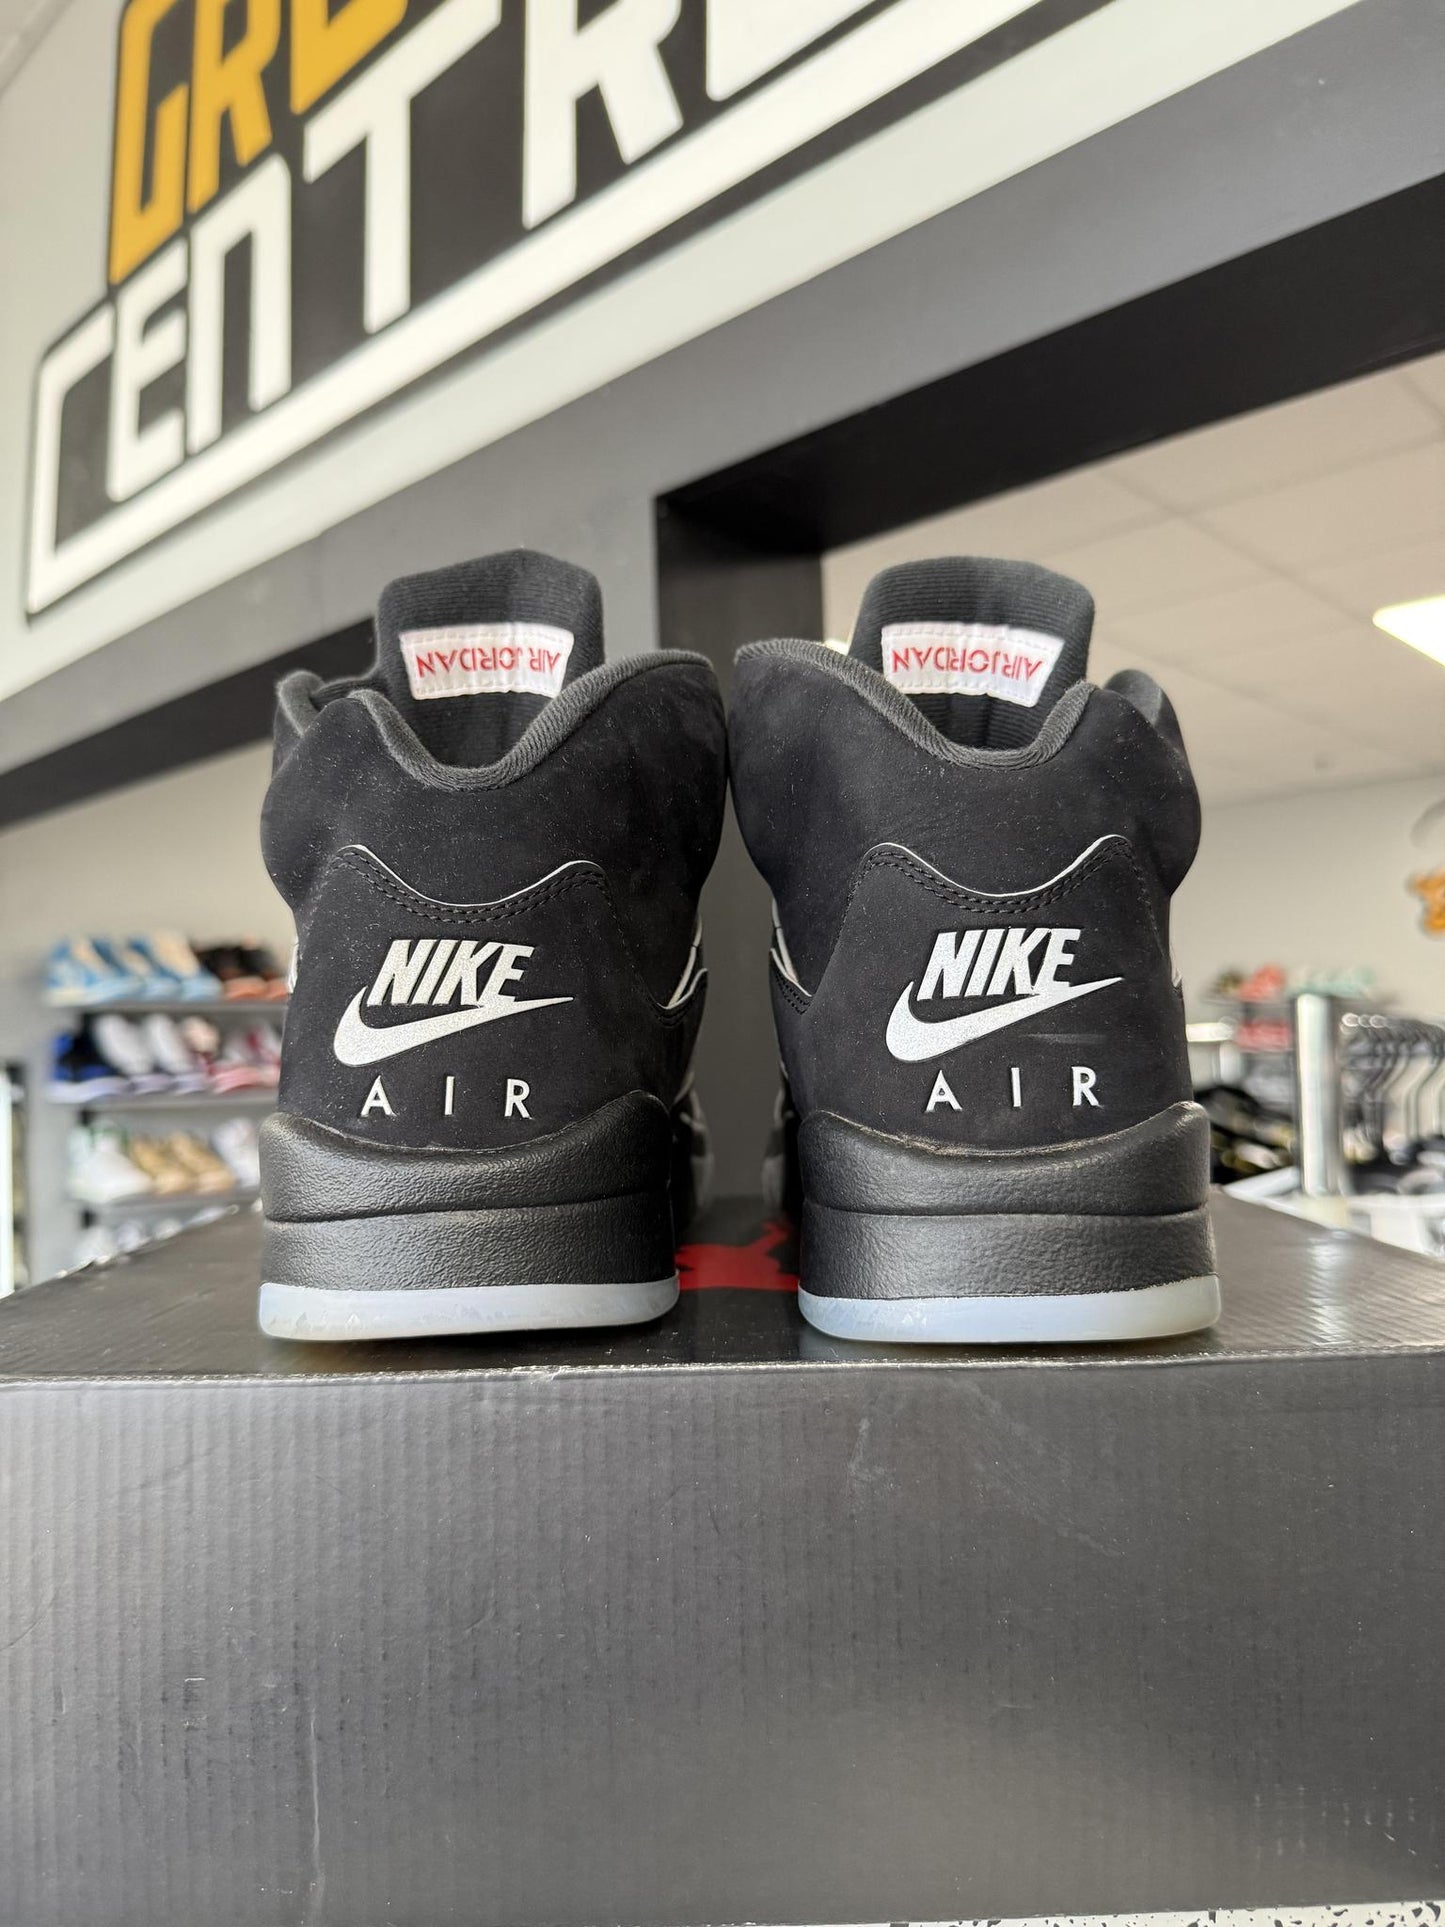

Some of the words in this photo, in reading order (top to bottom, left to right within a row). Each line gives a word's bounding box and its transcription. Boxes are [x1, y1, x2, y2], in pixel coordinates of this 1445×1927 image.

[108, 0, 412, 286] GR
[415, 647, 523, 678] JORDAN
[891, 646, 1001, 674] JORDAN
[366, 939, 535, 1008] NIKE
[916, 928, 1081, 1002] NIKE
[361, 1075, 533, 1120] AIR
[924, 1066, 1102, 1113] AIR
